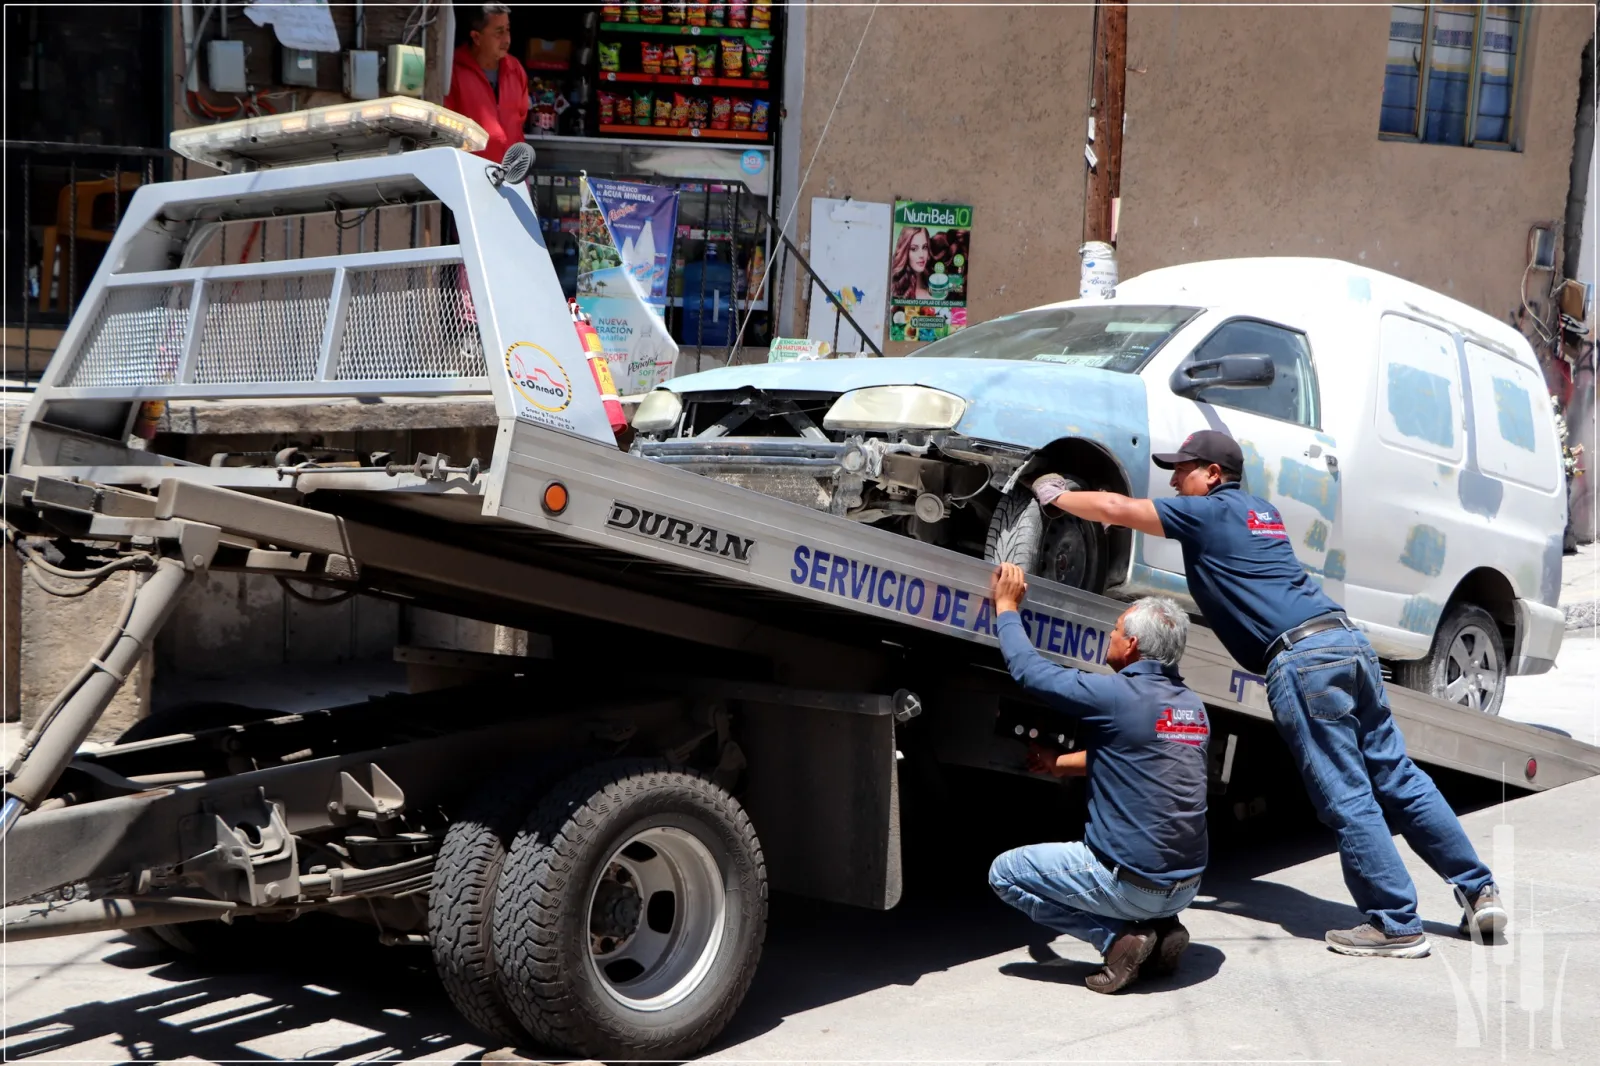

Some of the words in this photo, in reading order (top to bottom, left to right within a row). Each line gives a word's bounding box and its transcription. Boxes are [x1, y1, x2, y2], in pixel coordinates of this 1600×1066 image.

[602, 189, 622, 199] AGUA
[623, 192, 655, 203] MINERAL
[598, 318, 628, 326] NUEVA
[593, 326, 633, 334] ERACIÓN
[607, 501, 754, 562] DURAN
[790, 545, 926, 616] SERVICIO
[932, 583, 970, 628] DE
[973, 596, 1108, 666] ASTENCI
